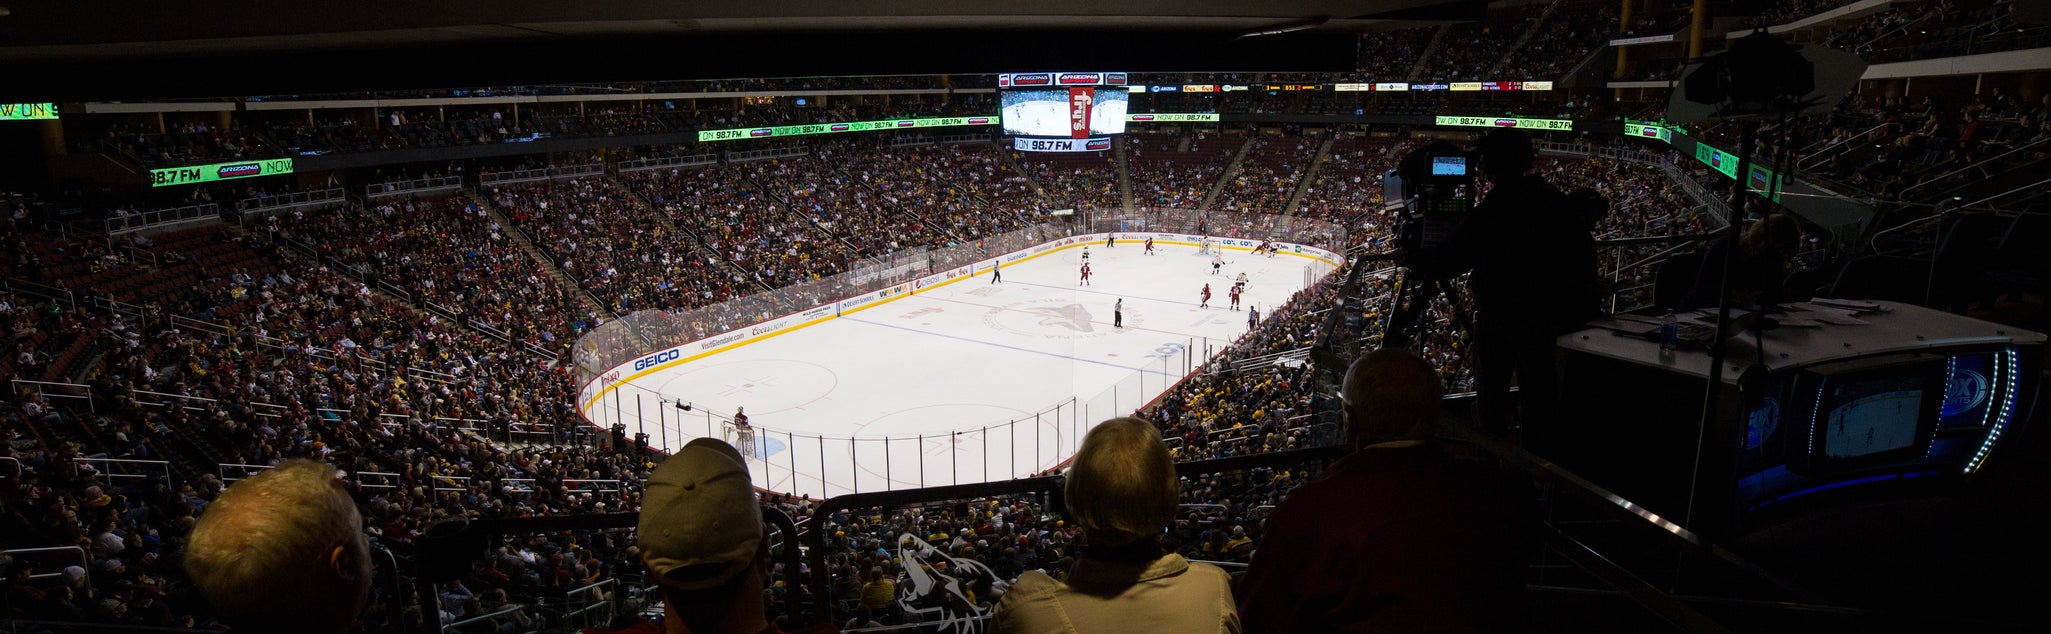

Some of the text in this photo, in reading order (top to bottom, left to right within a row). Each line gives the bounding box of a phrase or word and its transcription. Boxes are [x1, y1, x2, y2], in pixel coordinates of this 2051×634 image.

[21, 103, 44, 116] ON
[1520, 120, 1534, 128] NOW
[703, 132, 714, 140] ON
[716, 131, 731, 139] 98.7
[1031, 140, 1054, 150] 98.7
[1055, 140, 1072, 150] FM
[220, 164, 259, 173] ARIZONA
[179, 169, 200, 181] FM
[920, 275, 940, 288] pepsi
[634, 348, 680, 371] GEICO
